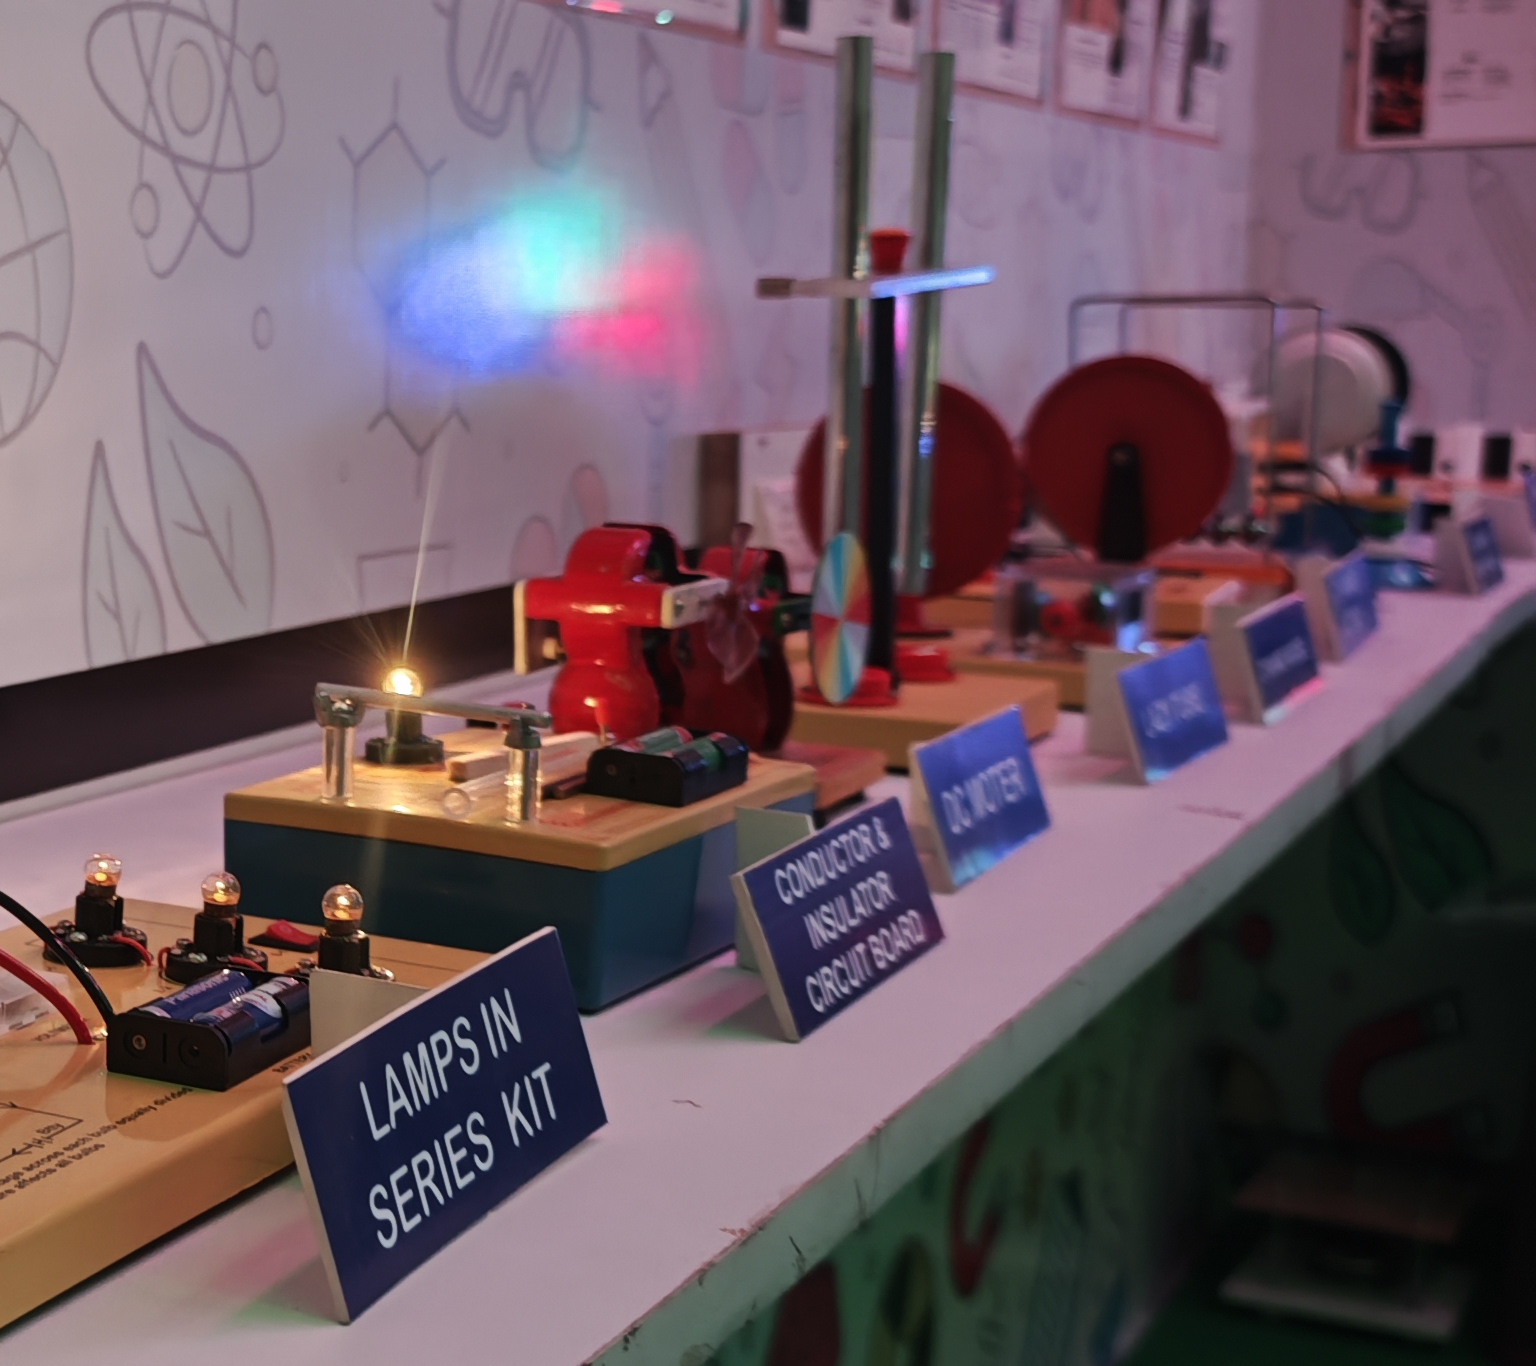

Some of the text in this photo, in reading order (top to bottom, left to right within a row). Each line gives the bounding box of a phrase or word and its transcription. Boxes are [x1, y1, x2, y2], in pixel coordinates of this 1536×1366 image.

[774, 816, 891, 906] CONDUCTOR &
[802, 870, 898, 951] INSULATOR
[805, 908, 927, 1014] CIRCUIT BOARD
[358, 987, 524, 1142] LAMPS IN
[15, 1166, 57, 1190] affects
[23, 1150, 63, 1172] across
[63, 1134, 94, 1152] each
[368, 1061, 558, 1249] SERIES KIT
